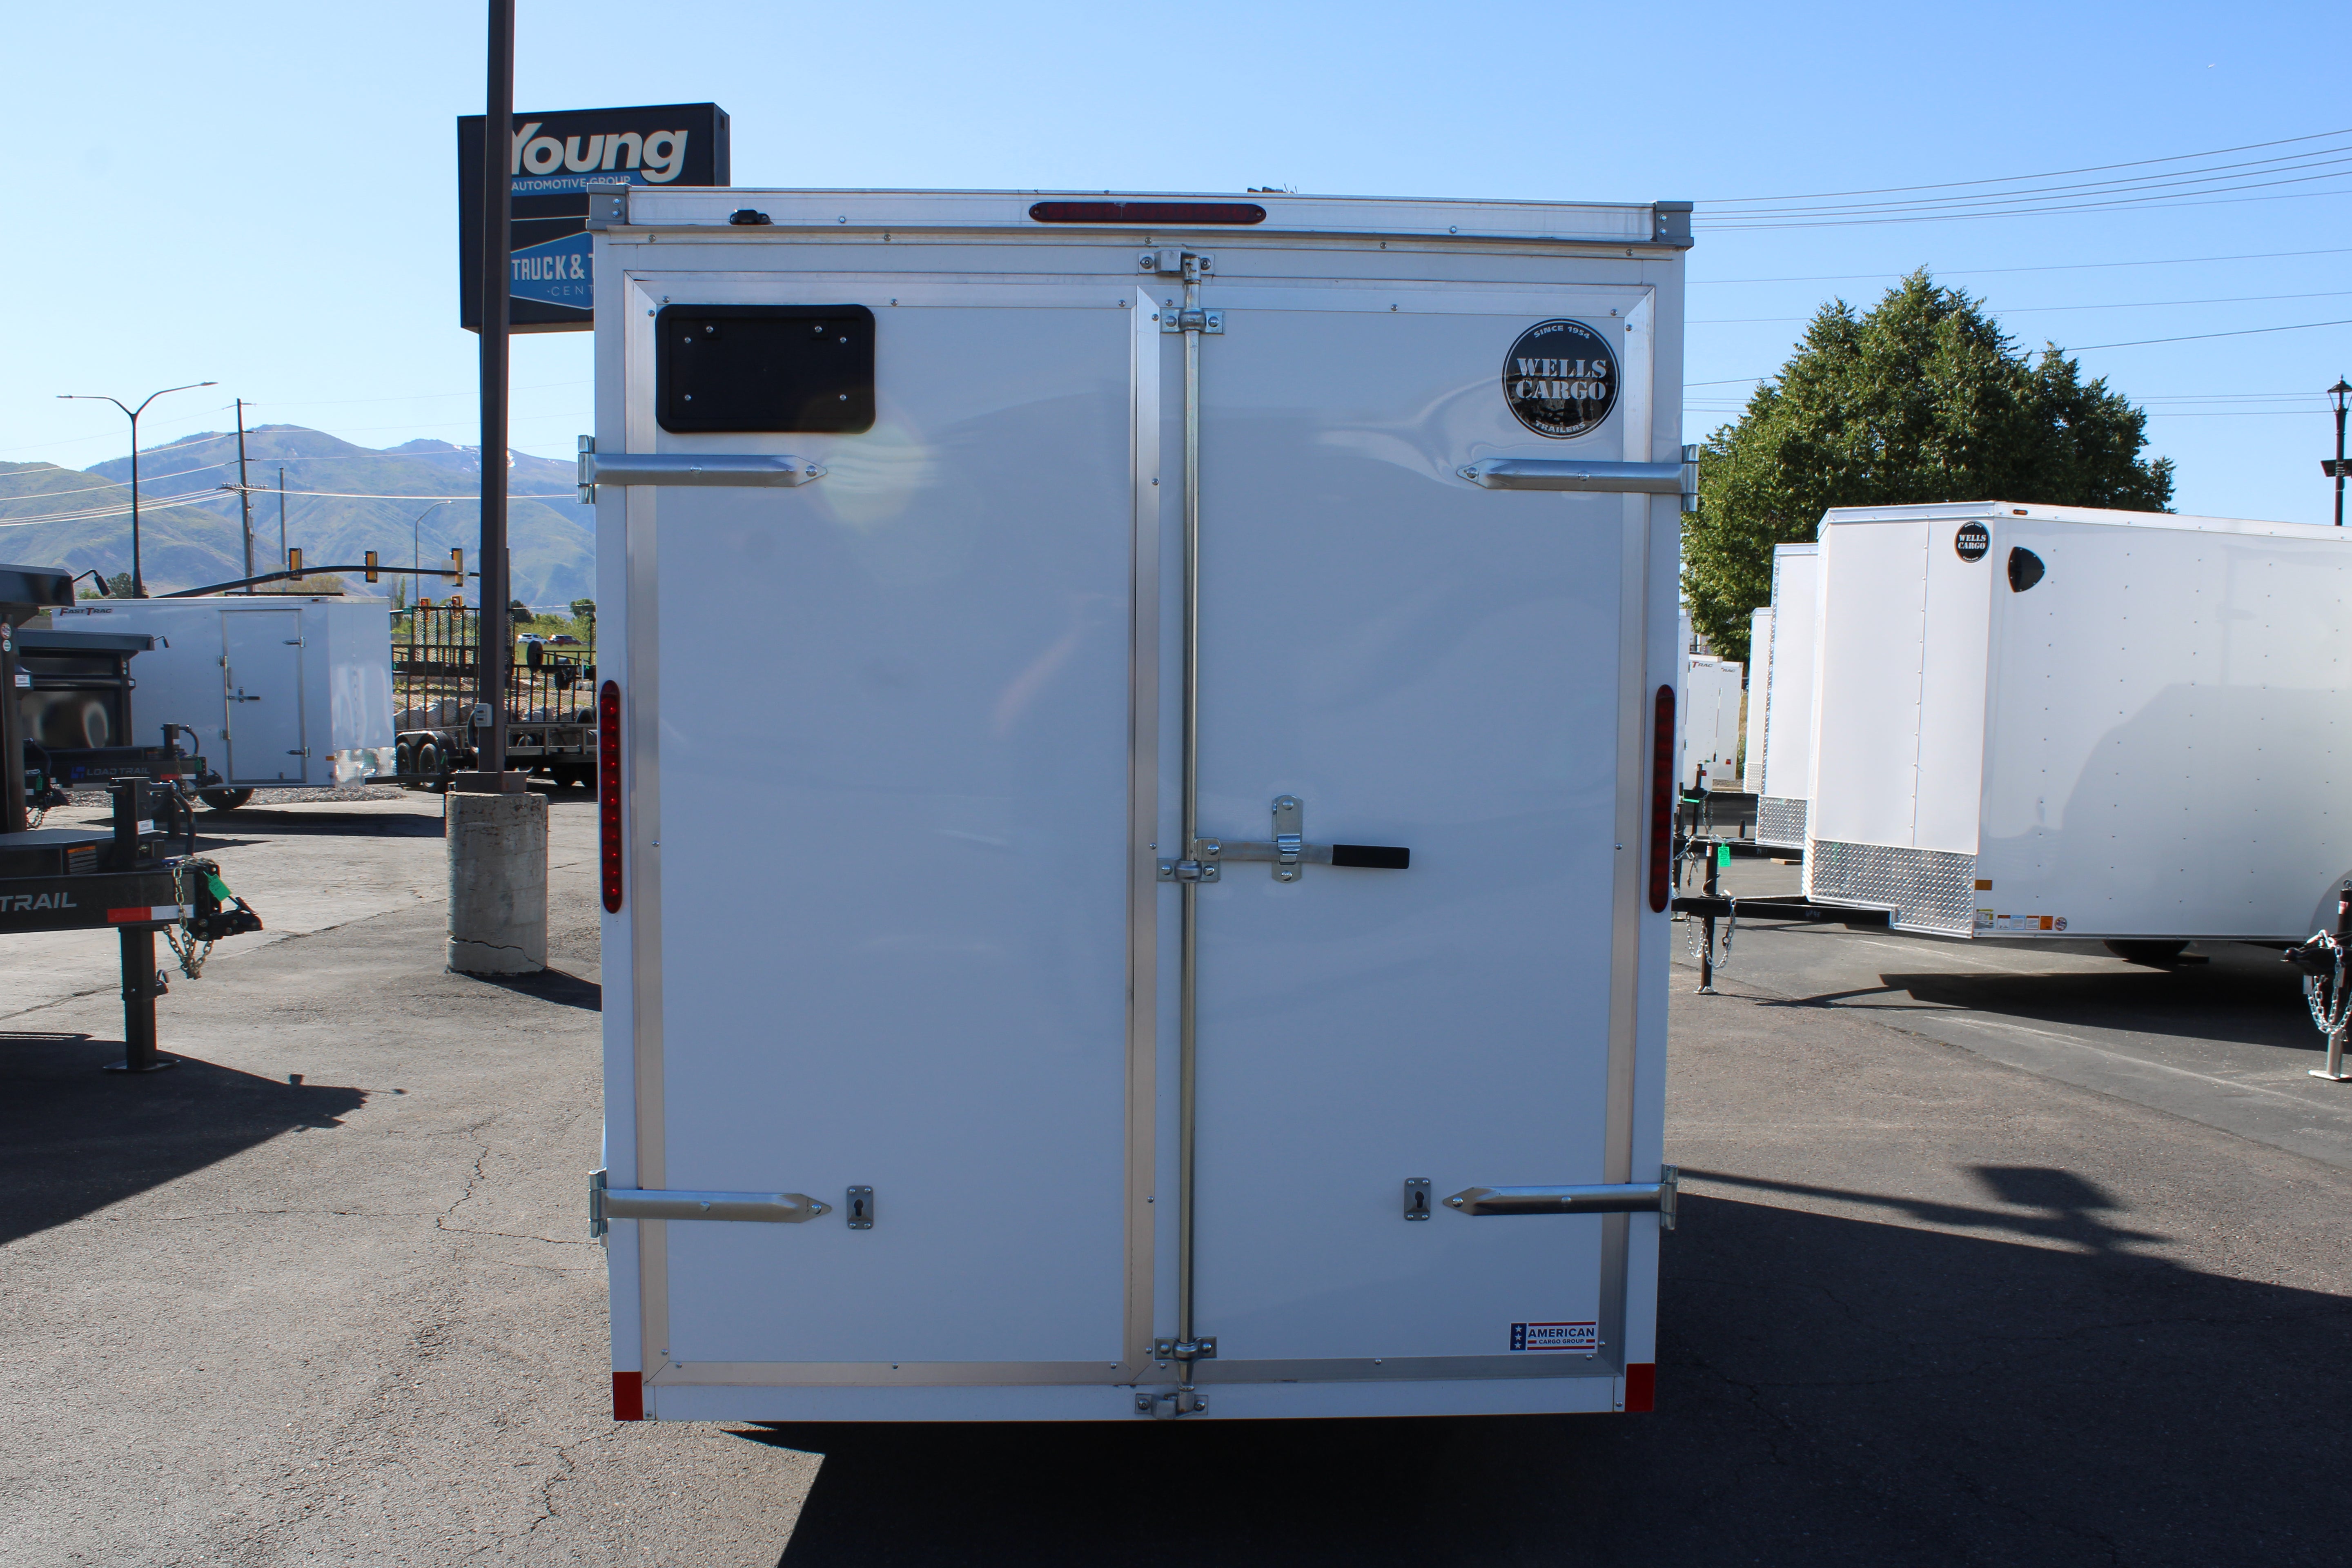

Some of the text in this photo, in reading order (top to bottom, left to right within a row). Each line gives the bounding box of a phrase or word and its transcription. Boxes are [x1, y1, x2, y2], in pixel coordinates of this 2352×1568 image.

[511, 122, 688, 183] Young
[511, 177, 586, 191] AUTOMOTIVE
[512, 255, 568, 281] TRUCK
[570, 254, 585, 280] &
[1533, 325, 1590, 339] SINCE 1954
[1517, 358, 1607, 378] WELLS
[1516, 380, 1606, 400] CARGO
[1535, 420, 1586, 433] TRAILERS
[0, 892, 77, 912] TRAIL
[1528, 1327, 1595, 1338] AMERICAN
